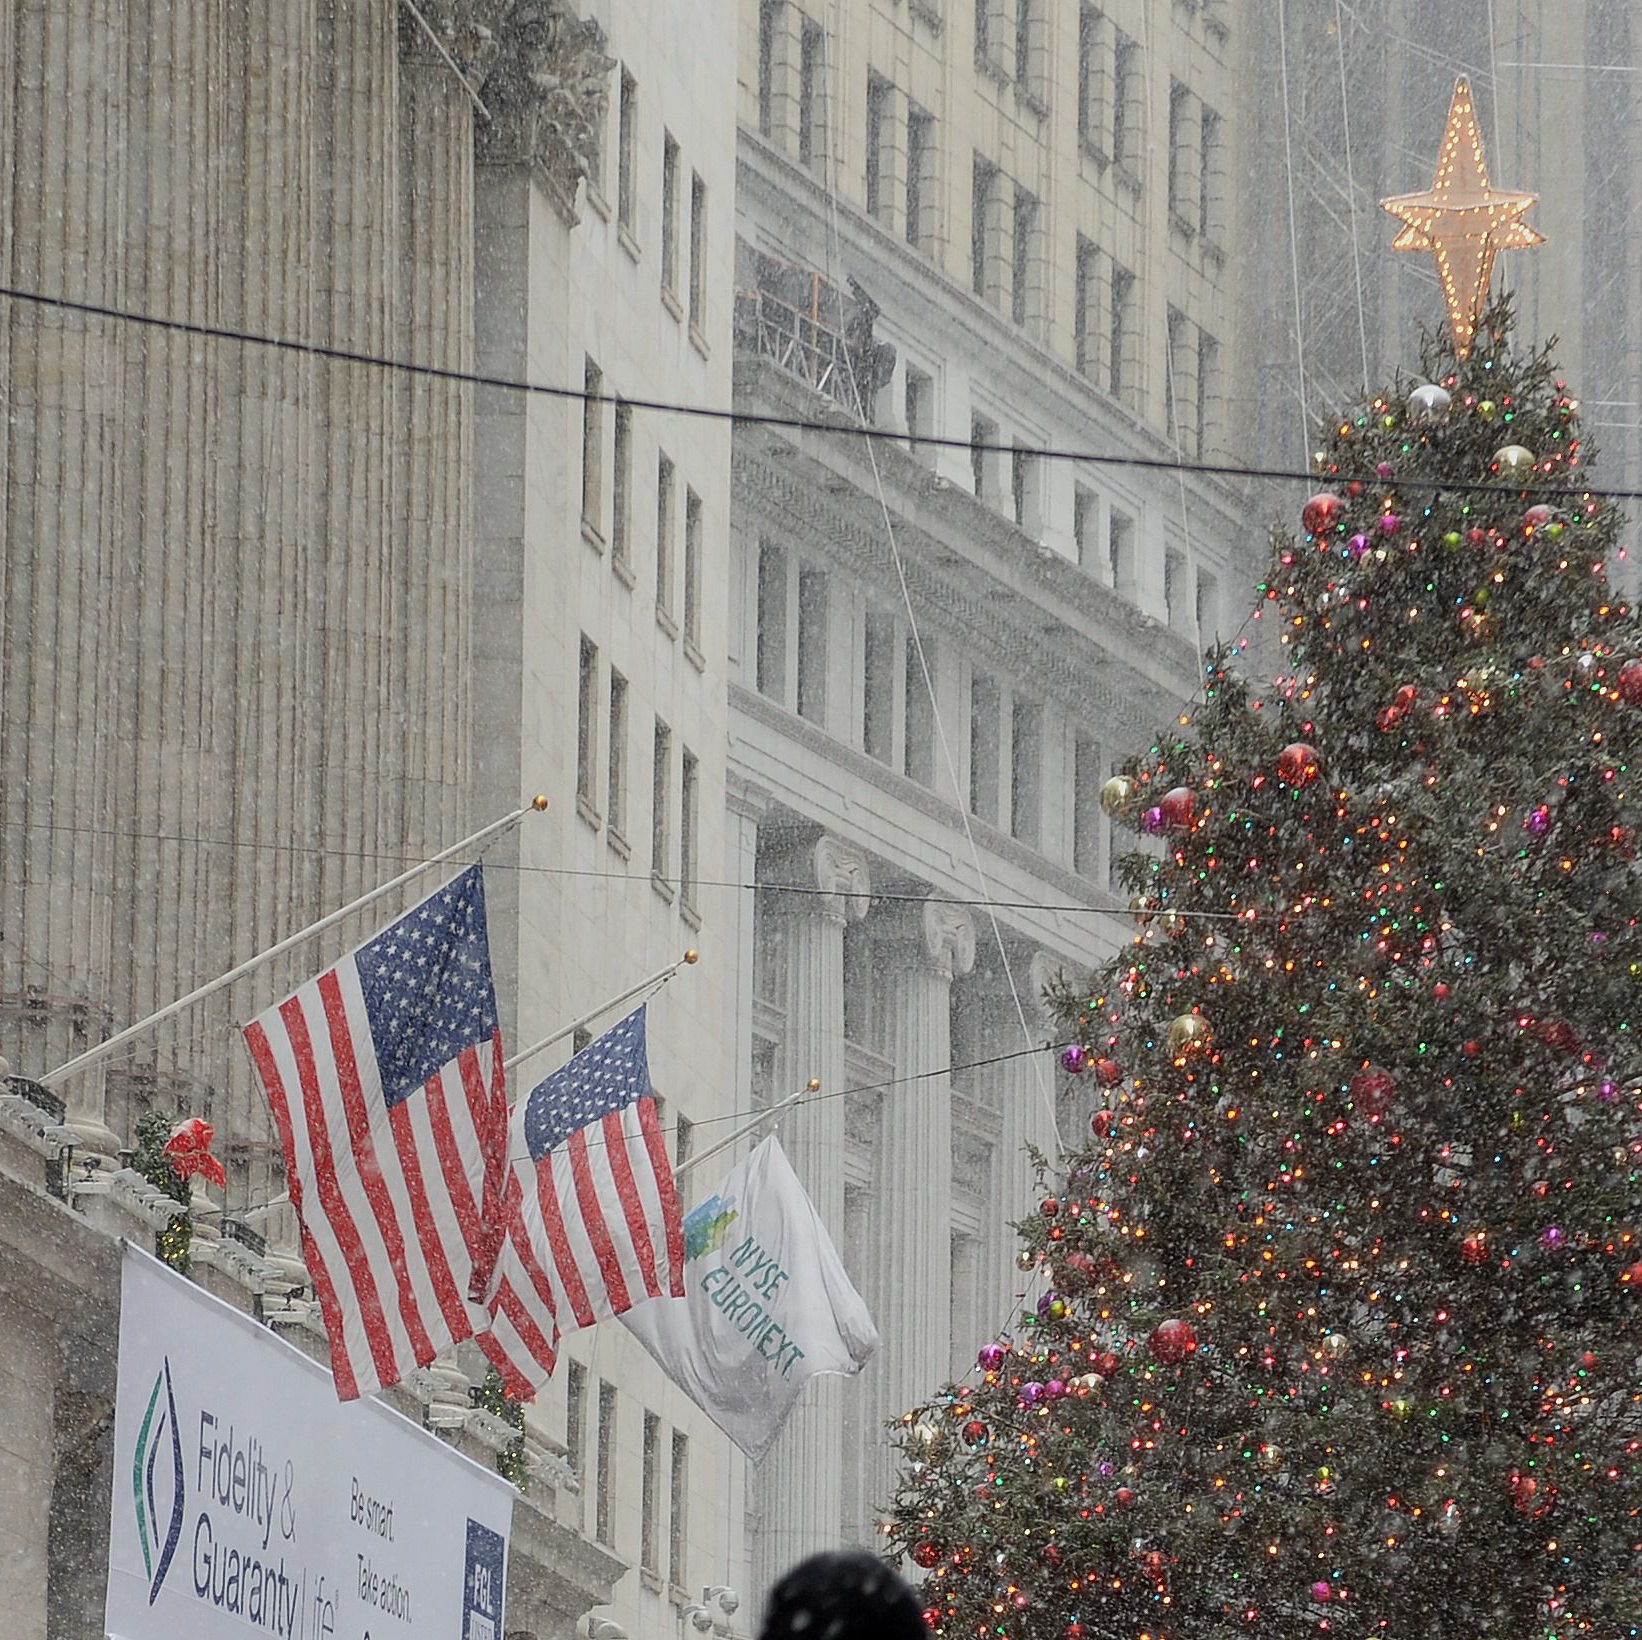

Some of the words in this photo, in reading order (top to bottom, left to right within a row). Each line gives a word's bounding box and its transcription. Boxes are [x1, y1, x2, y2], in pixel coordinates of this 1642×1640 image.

[729, 1235, 790, 1301] NYSE
[700, 1265, 805, 1381] EURONEXT
[196, 1409, 277, 1551] Fidelity
[280, 1459, 296, 1543] &
[350, 1476, 364, 1526] Be
[366, 1498, 395, 1543] smart.
[358, 1553, 378, 1607] Take
[380, 1571, 412, 1623] action.
[473, 1563, 493, 1615] FGL
